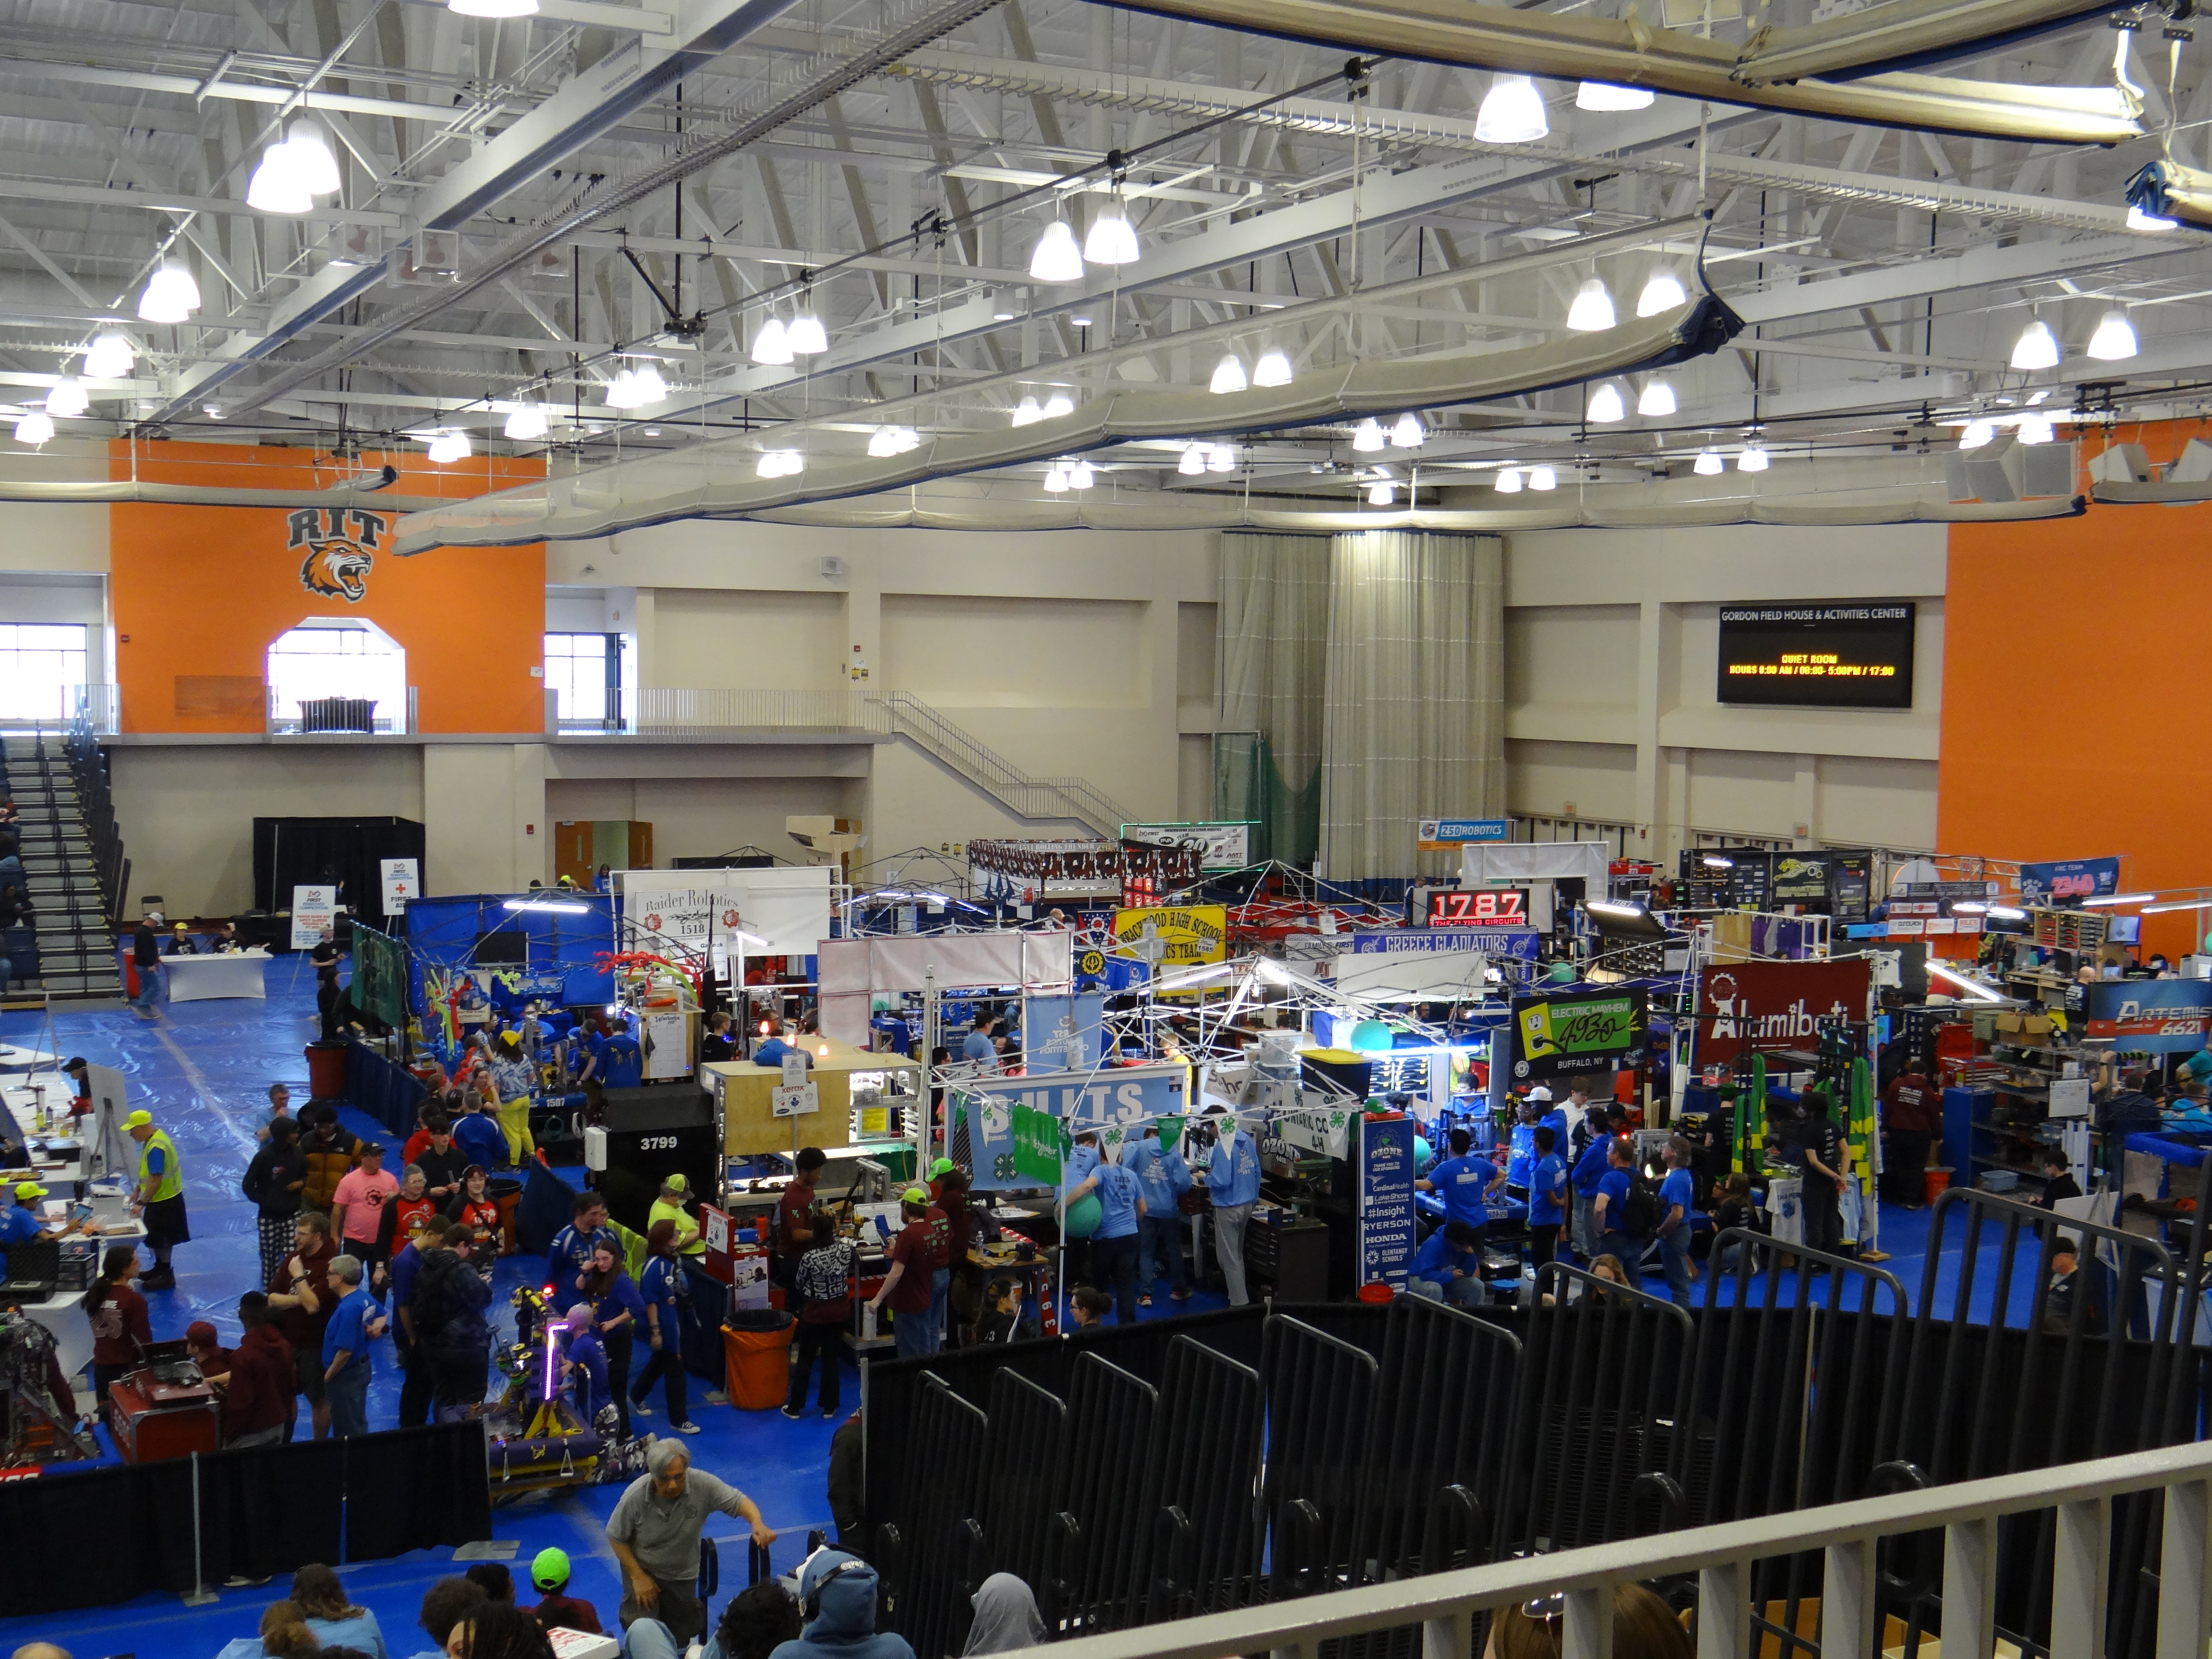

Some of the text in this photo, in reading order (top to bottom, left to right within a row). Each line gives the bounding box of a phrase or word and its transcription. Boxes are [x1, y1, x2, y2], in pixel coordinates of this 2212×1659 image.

[287, 508, 387, 551] RIT
[1722, 608, 1906, 621] GORDON FIELD HOUSE & ACTIVITIES CENTER
[1781, 655, 1837, 664] QUIET ROOM
[1729, 665, 1757, 674] HOURS
[1759, 665, 1777, 674] 8:00
[1779, 666, 1792, 674] AM
[1869, 666, 1894, 675] 17:00
[1441, 825, 1502, 836] 250 ROBOTICS
[2051, 874, 2095, 898] 2340
[646, 889, 738, 912] Raider Robotics
[1436, 893, 1522, 918] 1787
[1170, 912, 1191, 930] HIGH
[681, 924, 705, 934] 1518
[1335, 941, 1354, 949] FIRST
[1385, 934, 1508, 953] GREECE GLADIATORS
[1551, 1002, 1629, 1018] ELECTRIC MAYHEM
[2159, 1021, 2202, 1036] 6621
[1557, 1057, 1604, 1069] BUFFALO, NY
[782, 1085, 805, 1094] xerox
[546, 1098, 565, 1107] 1507
[1315, 1116, 1329, 1134] CO
[640, 1136, 678, 1150] 3799
[1312, 1134, 1325, 1153] 4-H
[1370, 1147, 1402, 1159] OZONE
[1275, 1155, 1287, 1164] 4611
[1373, 1182, 1410, 1192] CardinalHealth
[1364, 1219, 1411, 1231] RYERSON
[1365, 1233, 1407, 1244] HONDA
[1382, 1247, 1408, 1256] OLENTANGY
[1382, 1255, 1403, 1263] SCHOOLS
